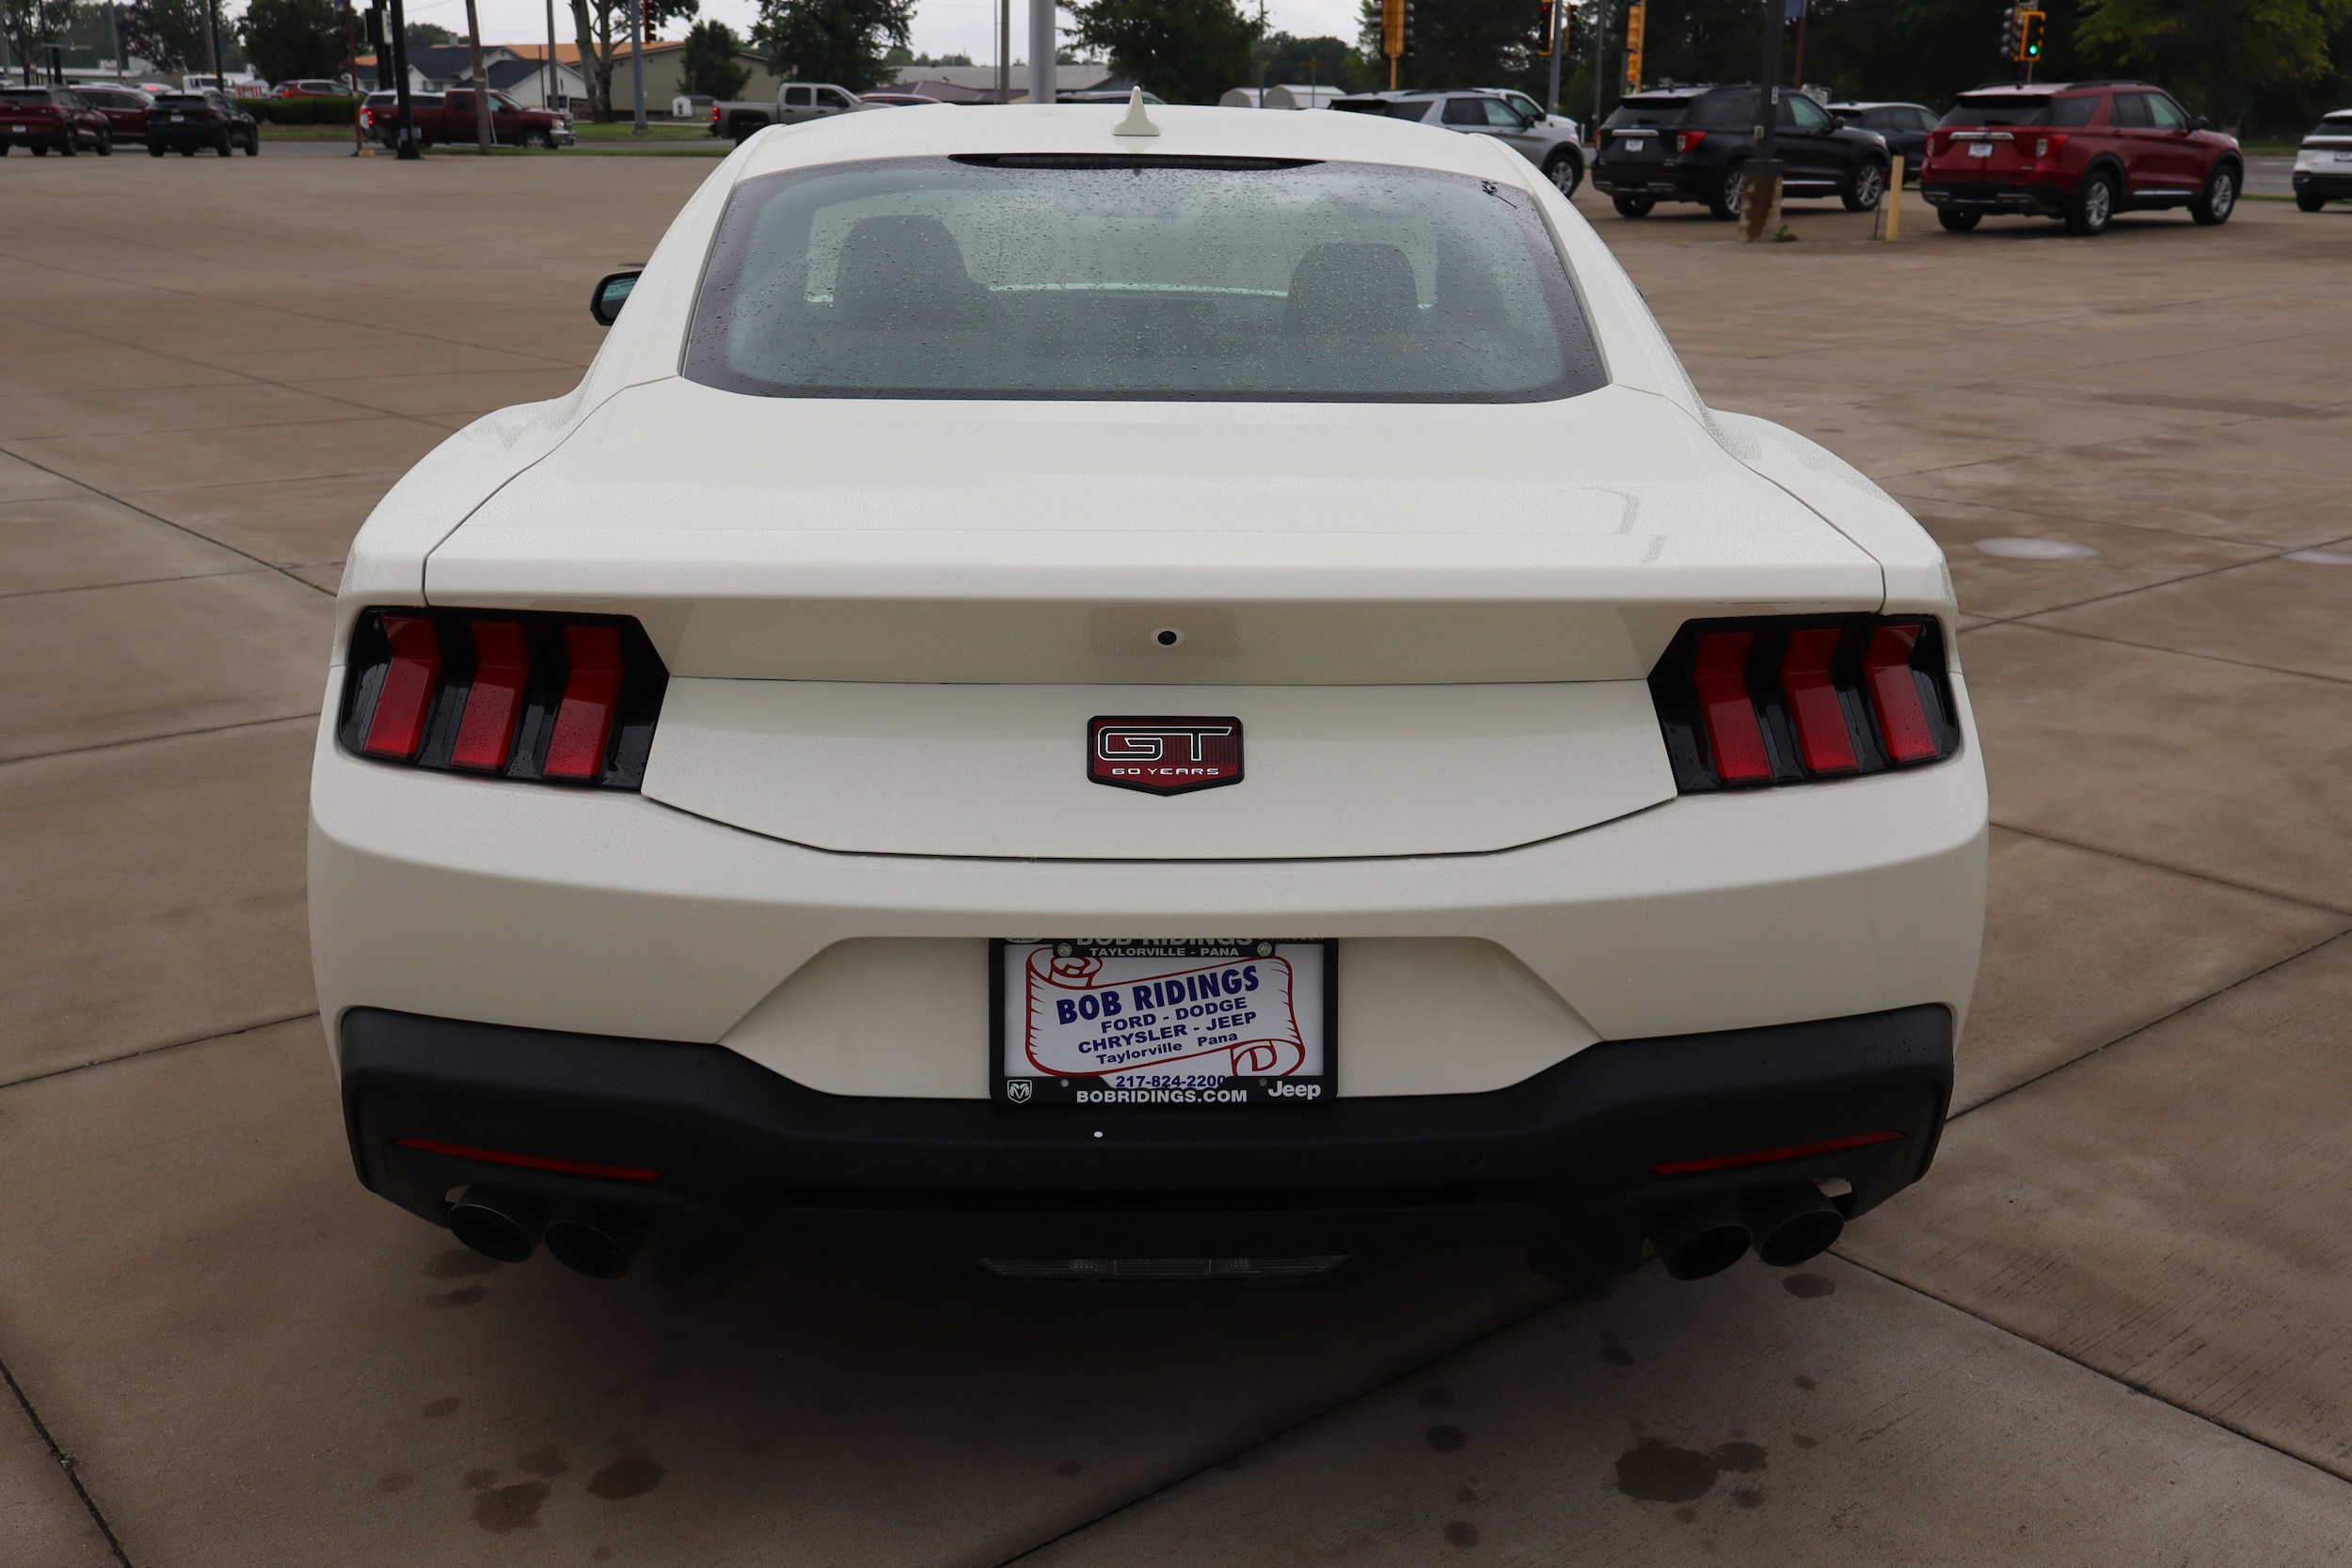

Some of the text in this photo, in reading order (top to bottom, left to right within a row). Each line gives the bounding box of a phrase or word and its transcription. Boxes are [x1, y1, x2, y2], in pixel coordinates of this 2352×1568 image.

[1098, 725, 1232, 761] GT
[1089, 947, 1185, 957] TAYLORVILLE
[1200, 947, 1240, 957] PANA
[1056, 965, 1260, 1025] BOB RIDINGS
[1101, 1013, 1157, 1034] FORD
[1175, 996, 1248, 1021] DODGE
[1078, 1023, 1188, 1053] CHRYSLER
[1206, 1011, 1257, 1031] JEEP
[1096, 1033, 1239, 1065] Taylorville Pana
[1076, 1089, 1248, 1103] BOBRIDINGS.COM
[1115, 1075, 1225, 1088] 217-824-2200
[1268, 1081, 1322, 1101] Jeep
